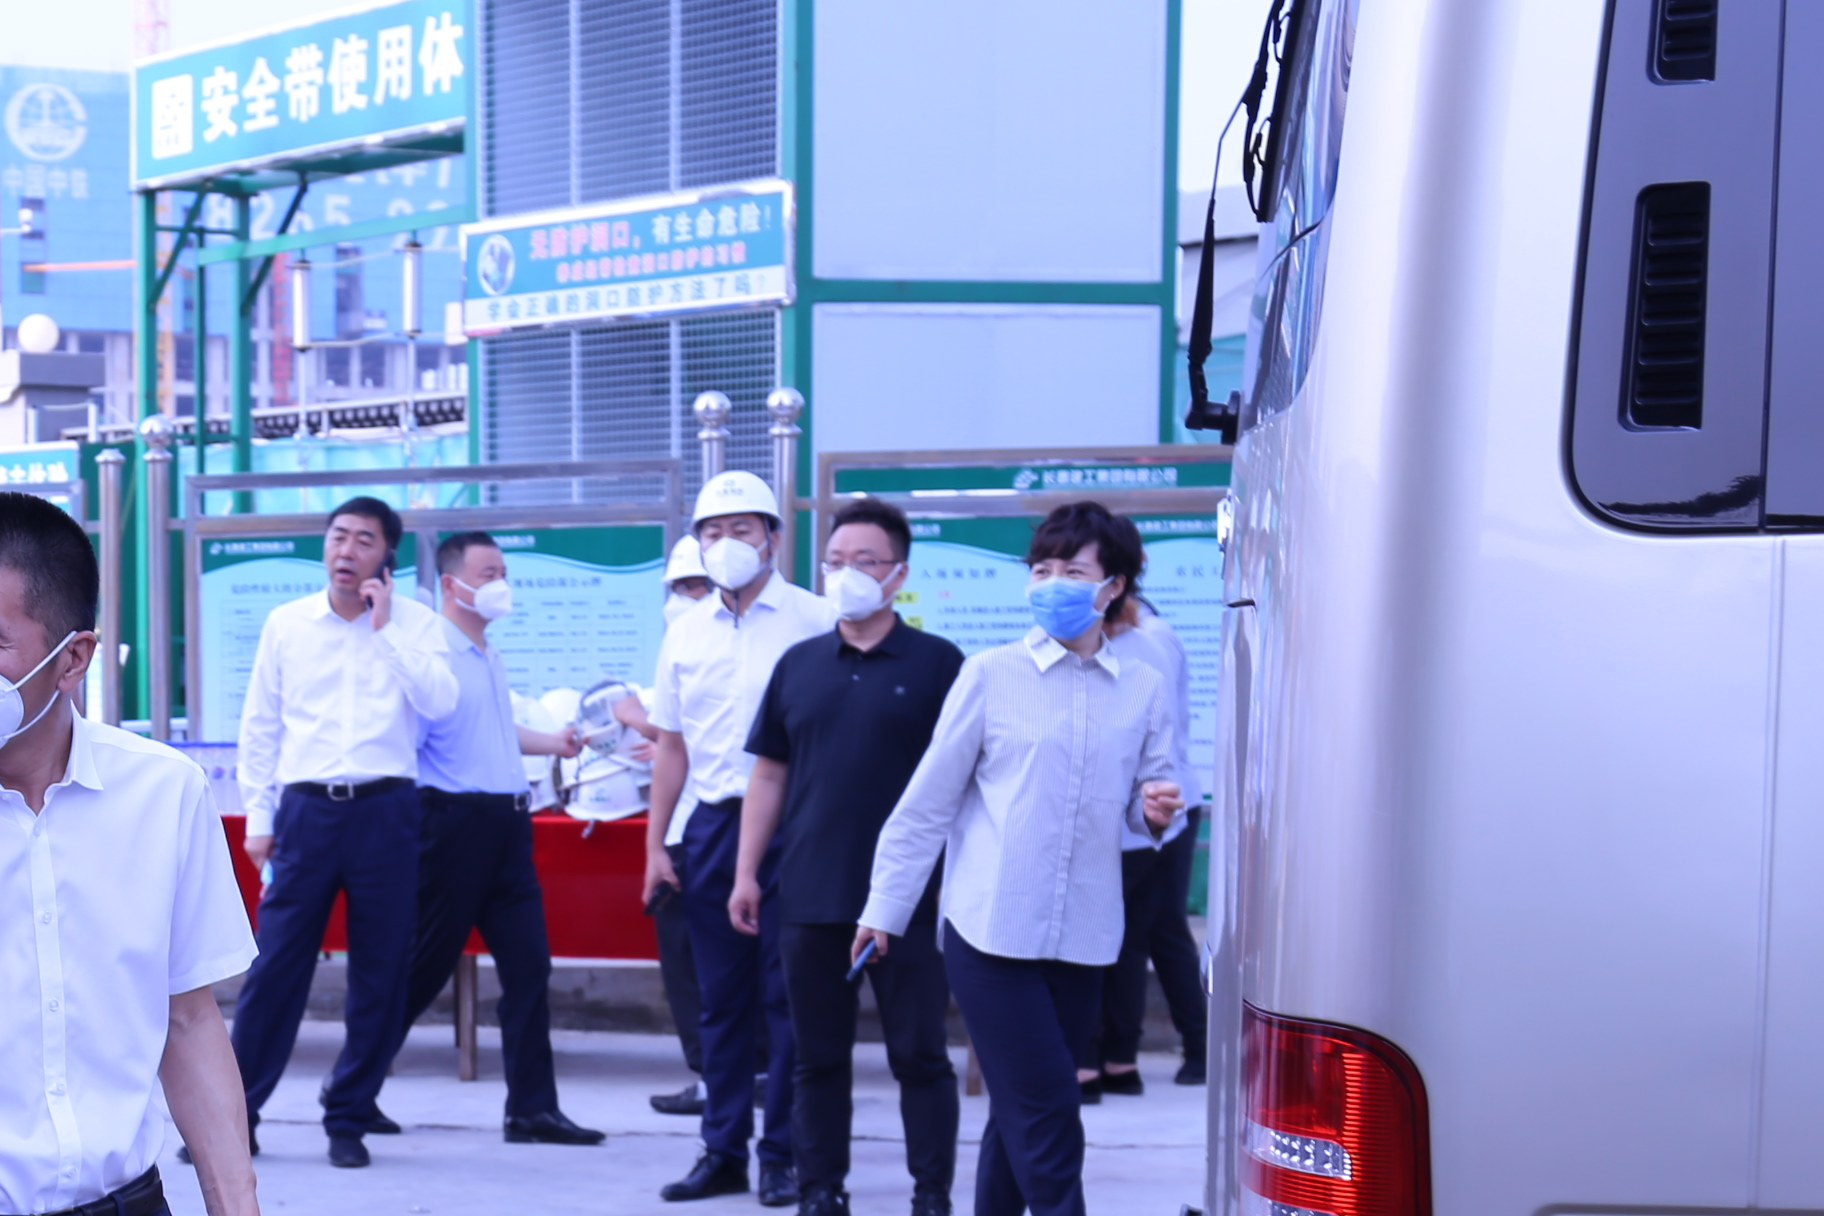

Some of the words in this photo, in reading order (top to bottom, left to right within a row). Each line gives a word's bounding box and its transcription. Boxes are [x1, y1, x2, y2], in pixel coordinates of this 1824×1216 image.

[200, 11, 464, 143] 安全带使用体
